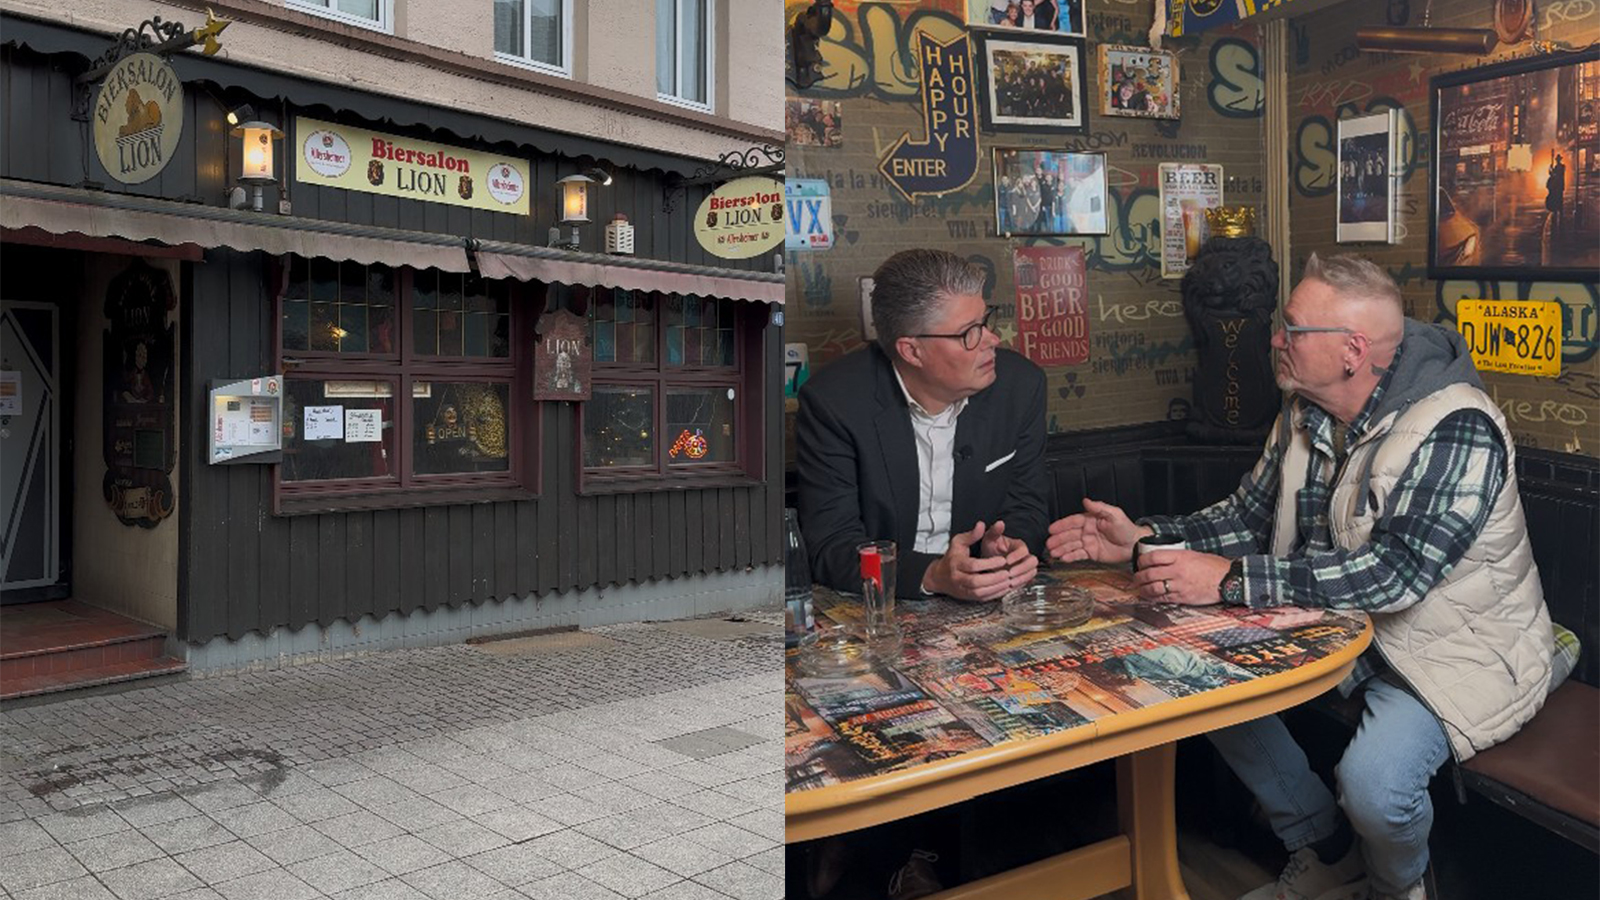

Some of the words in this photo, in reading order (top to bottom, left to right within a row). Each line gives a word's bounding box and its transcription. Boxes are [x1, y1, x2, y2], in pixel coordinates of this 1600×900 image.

[98, 59, 178, 125] BIERSALON
[926, 46, 950, 153] HAPPY
[949, 54, 970, 138] HOUR
[119, 134, 163, 175] LION
[371, 137, 470, 174] Biersalon
[893, 159, 947, 177] ENTER
[1165, 171, 1218, 185] BEER
[396, 167, 447, 196] LION
[709, 192, 782, 210] Biersalon
[725, 207, 762, 226] LION
[947, 221, 977, 238] VIVA
[1040, 273, 1084, 289] GOOD
[1020, 287, 1084, 321] BEER
[1484, 305, 1539, 319] ALASKA
[1041, 316, 1085, 338] GOOD
[546, 339, 580, 356] LION
[1023, 331, 1088, 360] FRIENDS
[1461, 321, 1502, 357] DJW
[1517, 324, 1556, 362] 826
[438, 426, 466, 440] OPEN
